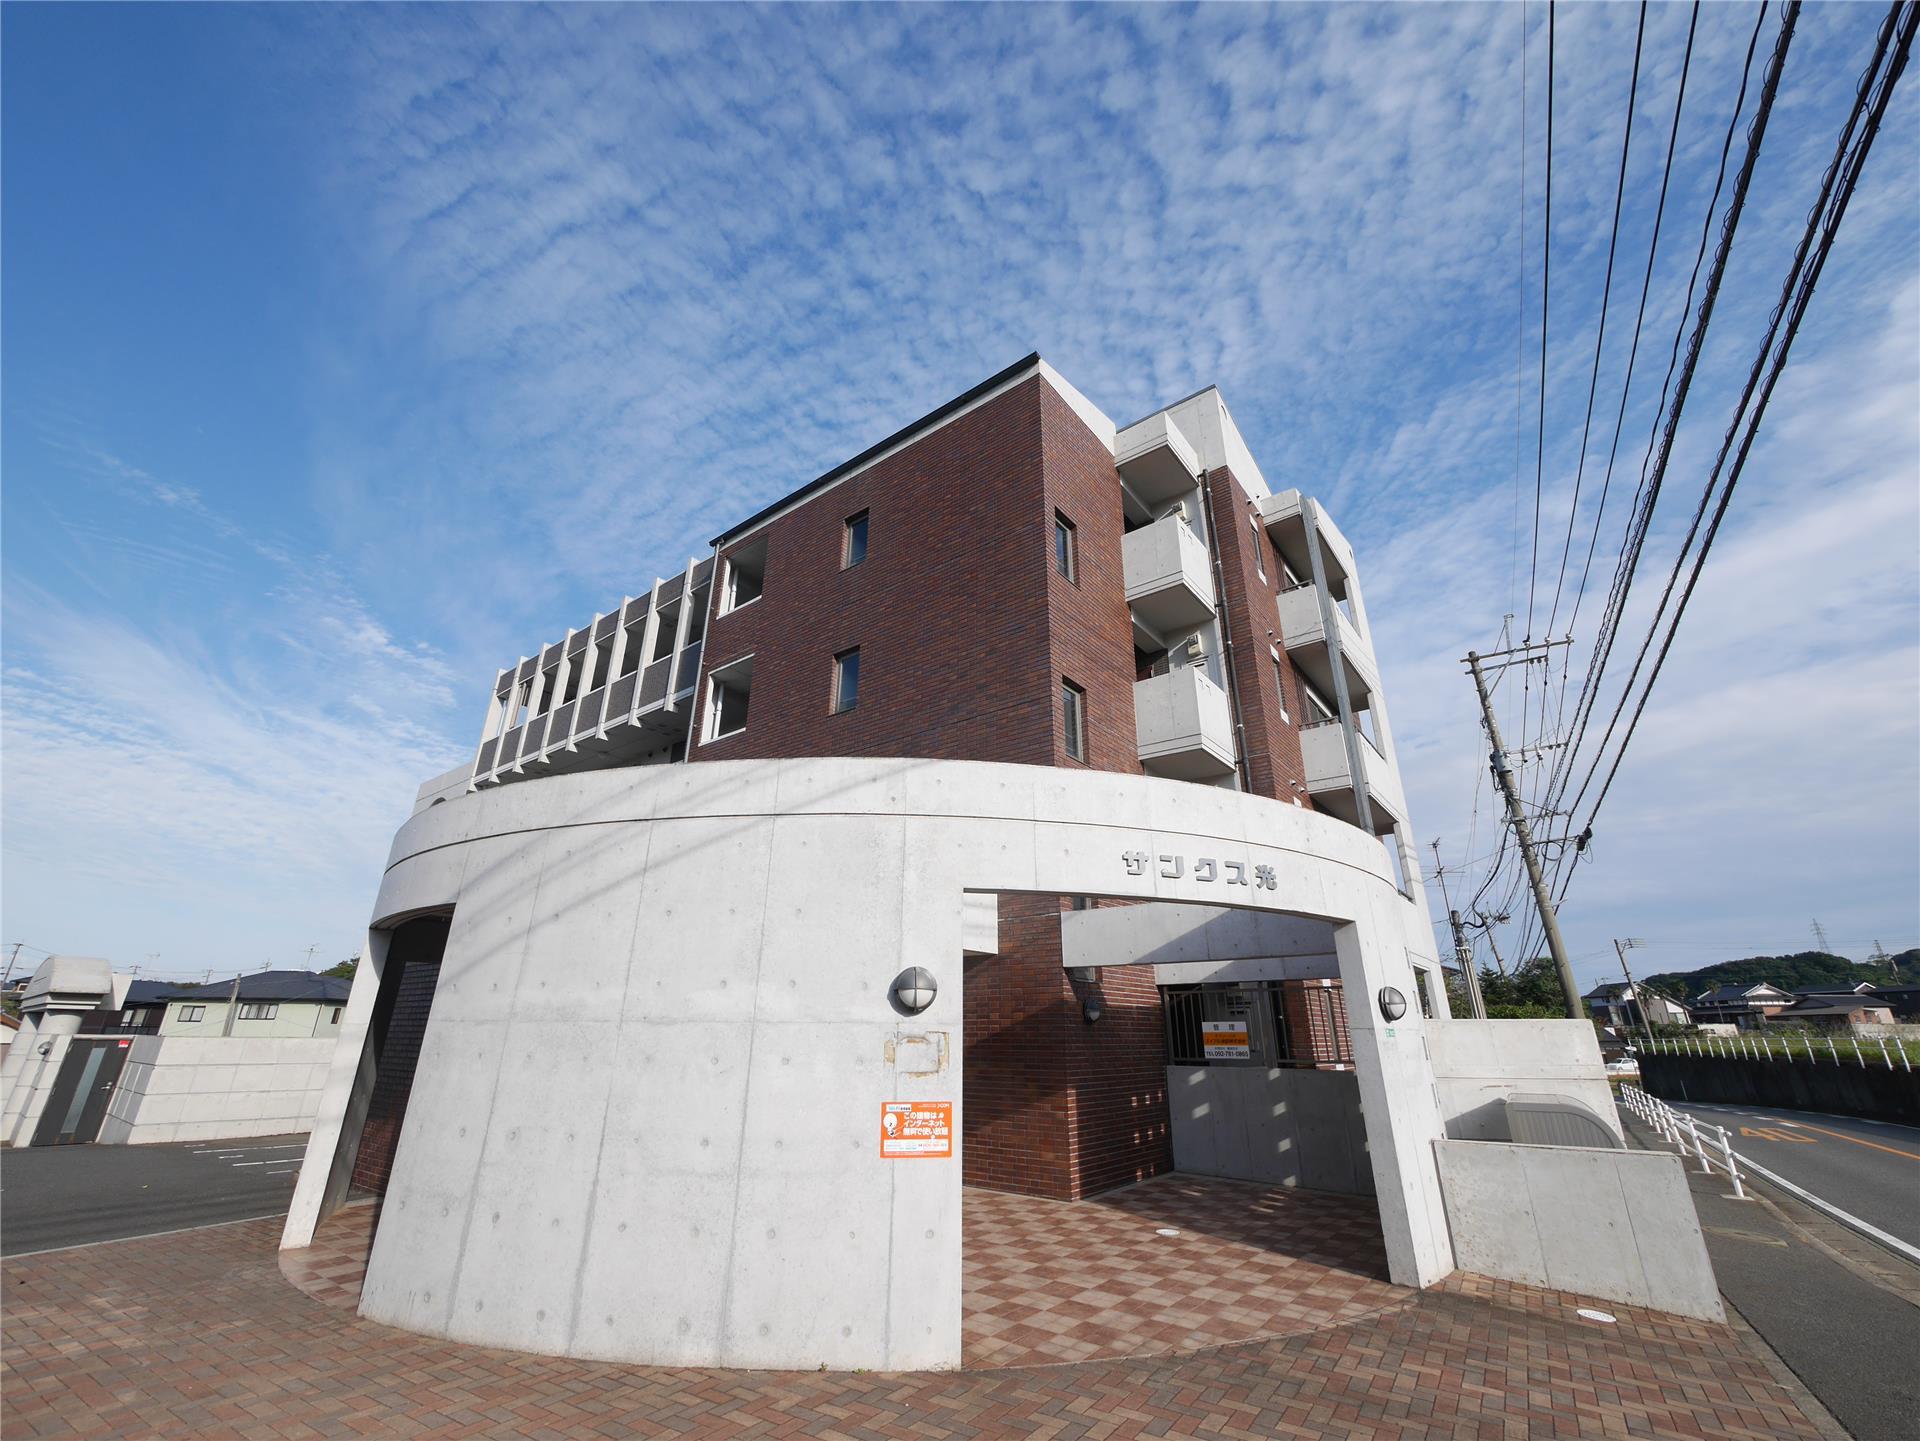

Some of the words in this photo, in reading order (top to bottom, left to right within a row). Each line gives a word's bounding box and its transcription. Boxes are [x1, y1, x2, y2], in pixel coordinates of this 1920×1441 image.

[1122, 850, 1277, 890] サンクス光
